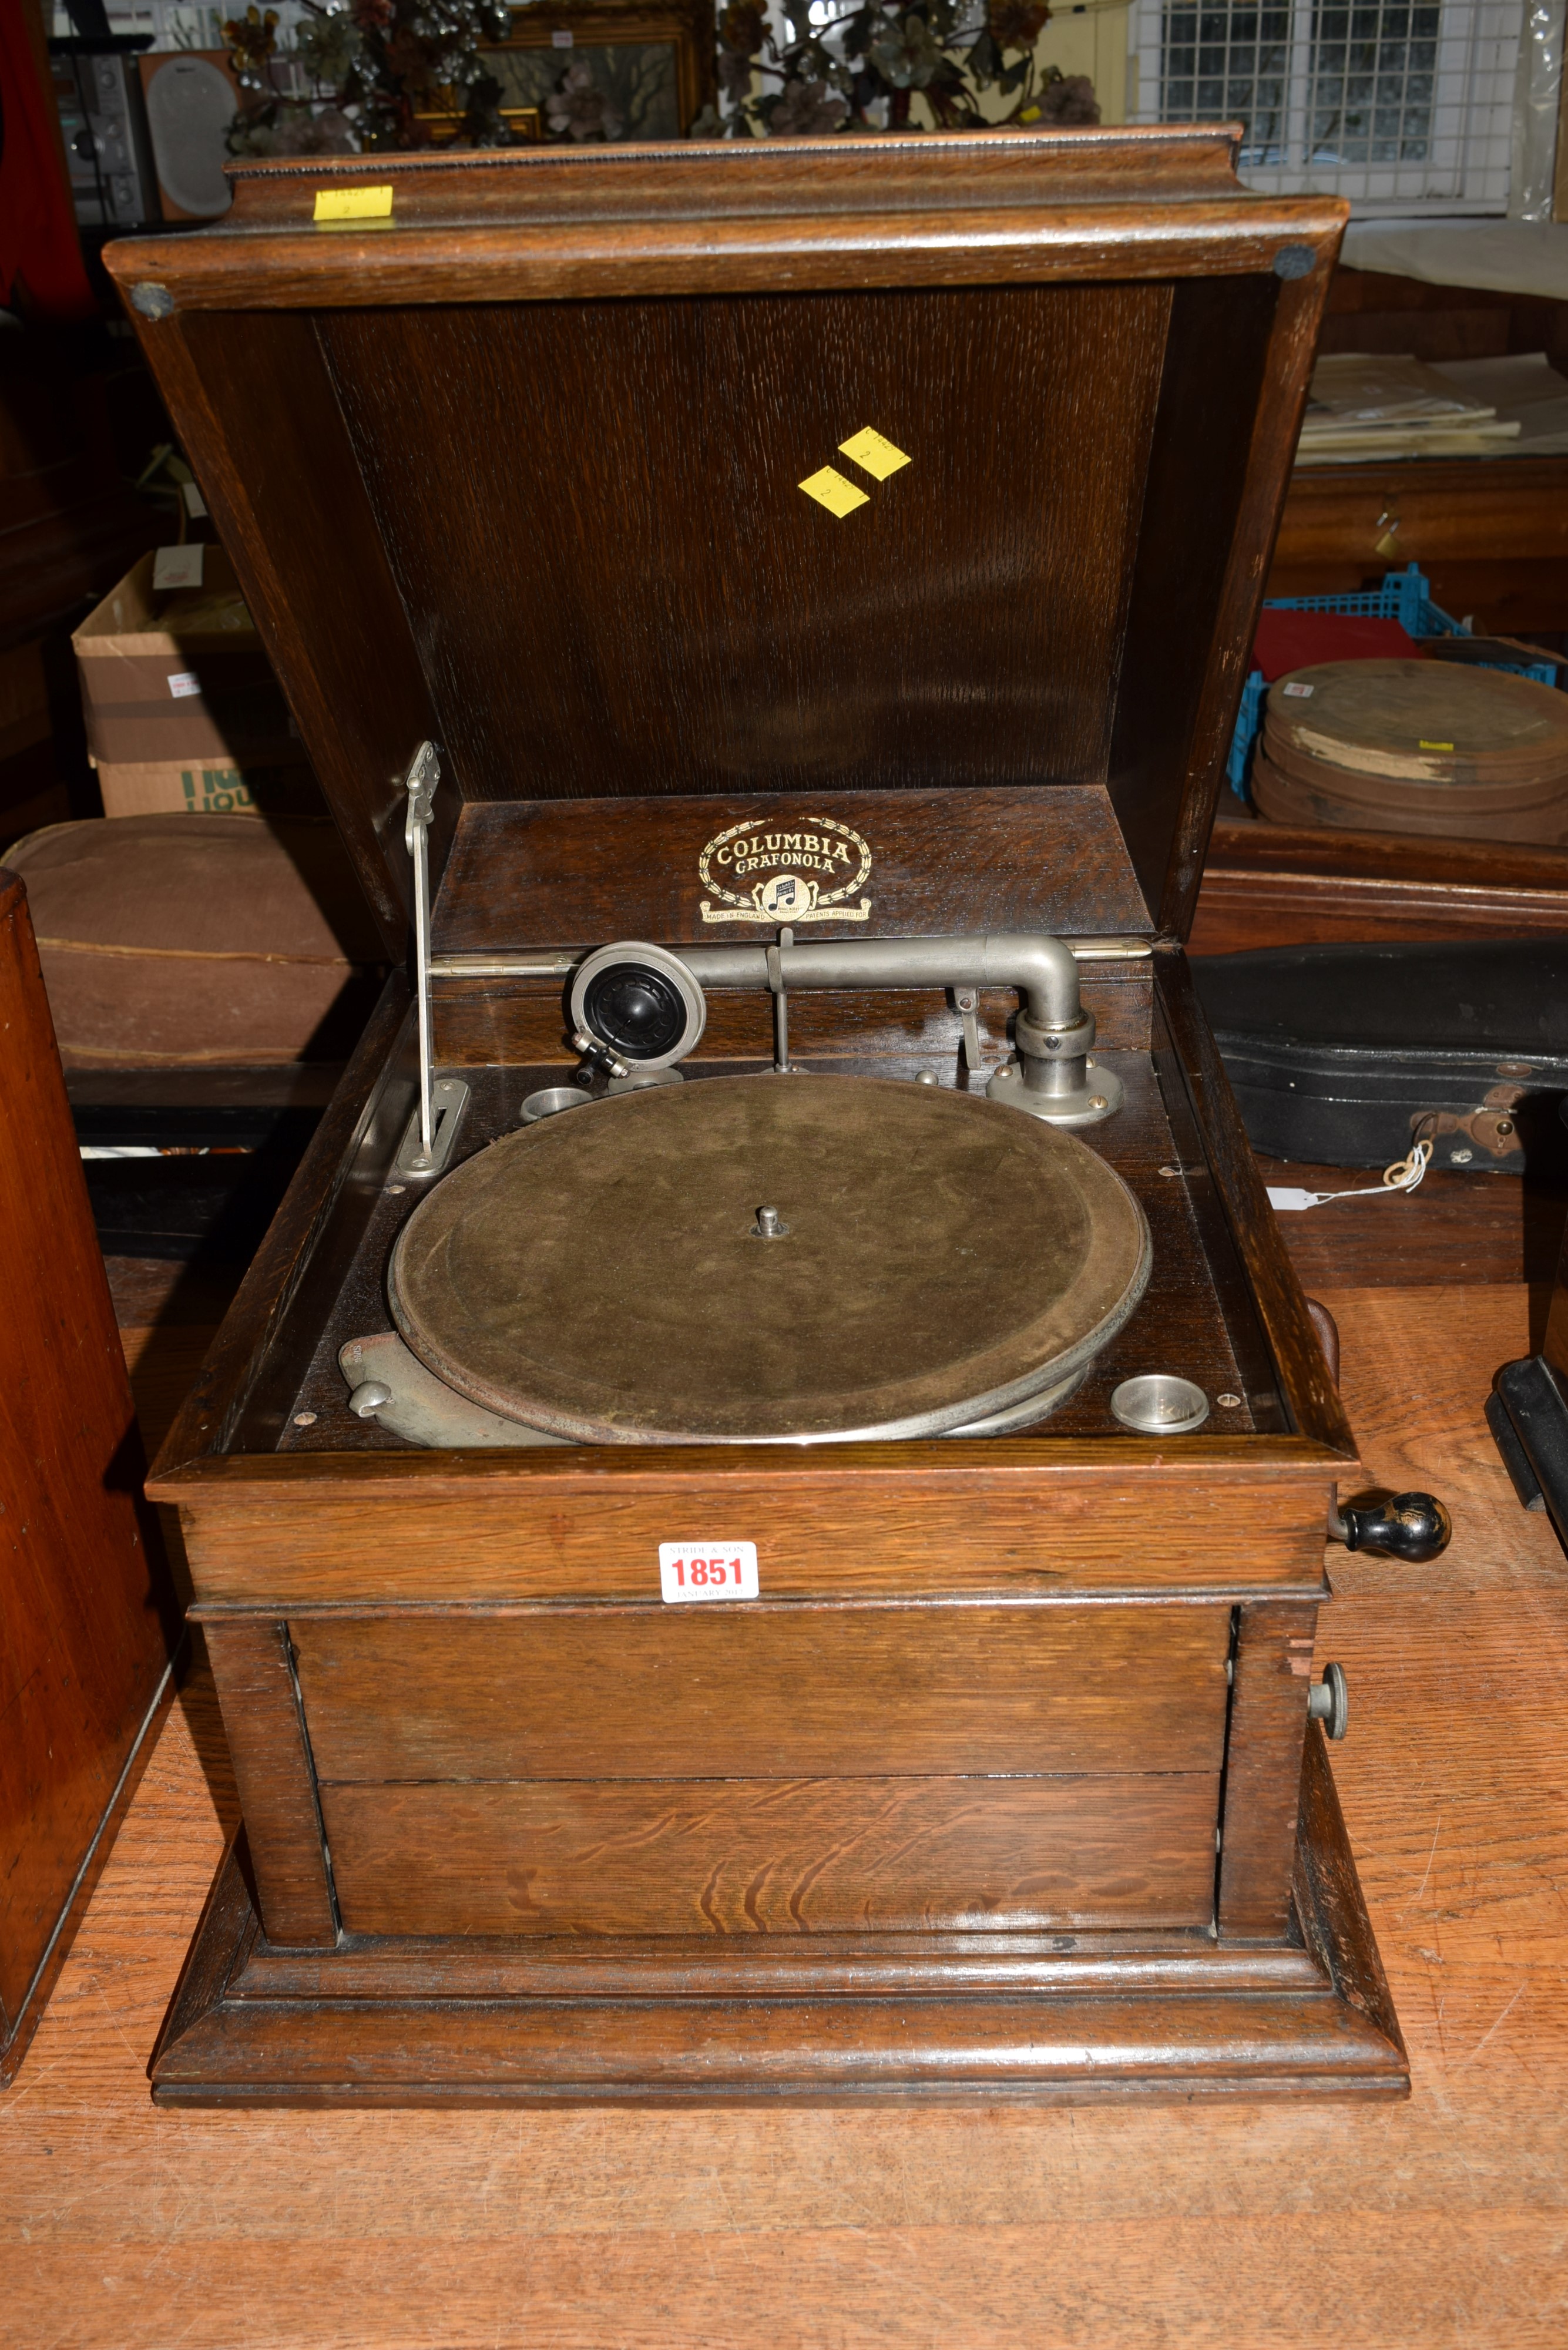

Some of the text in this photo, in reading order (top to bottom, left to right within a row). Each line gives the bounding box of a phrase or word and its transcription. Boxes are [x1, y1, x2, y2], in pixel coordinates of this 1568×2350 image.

[873, 434, 896, 452] 14429
[859, 451, 871, 459] 2
[820, 488, 831, 497] 2
[717, 834, 851, 865] COLUMBIA
[736, 852, 835, 874] GRAFONOLA
[777, 880, 795, 890] Columbia
[777, 888, 794, 897] Records
[805, 911, 830, 919] PATENTS
[670, 1546, 706, 1555] STRIDE
[672, 1558, 741, 1586] 1851
[677, 1589, 721, 1598] JANUARY
